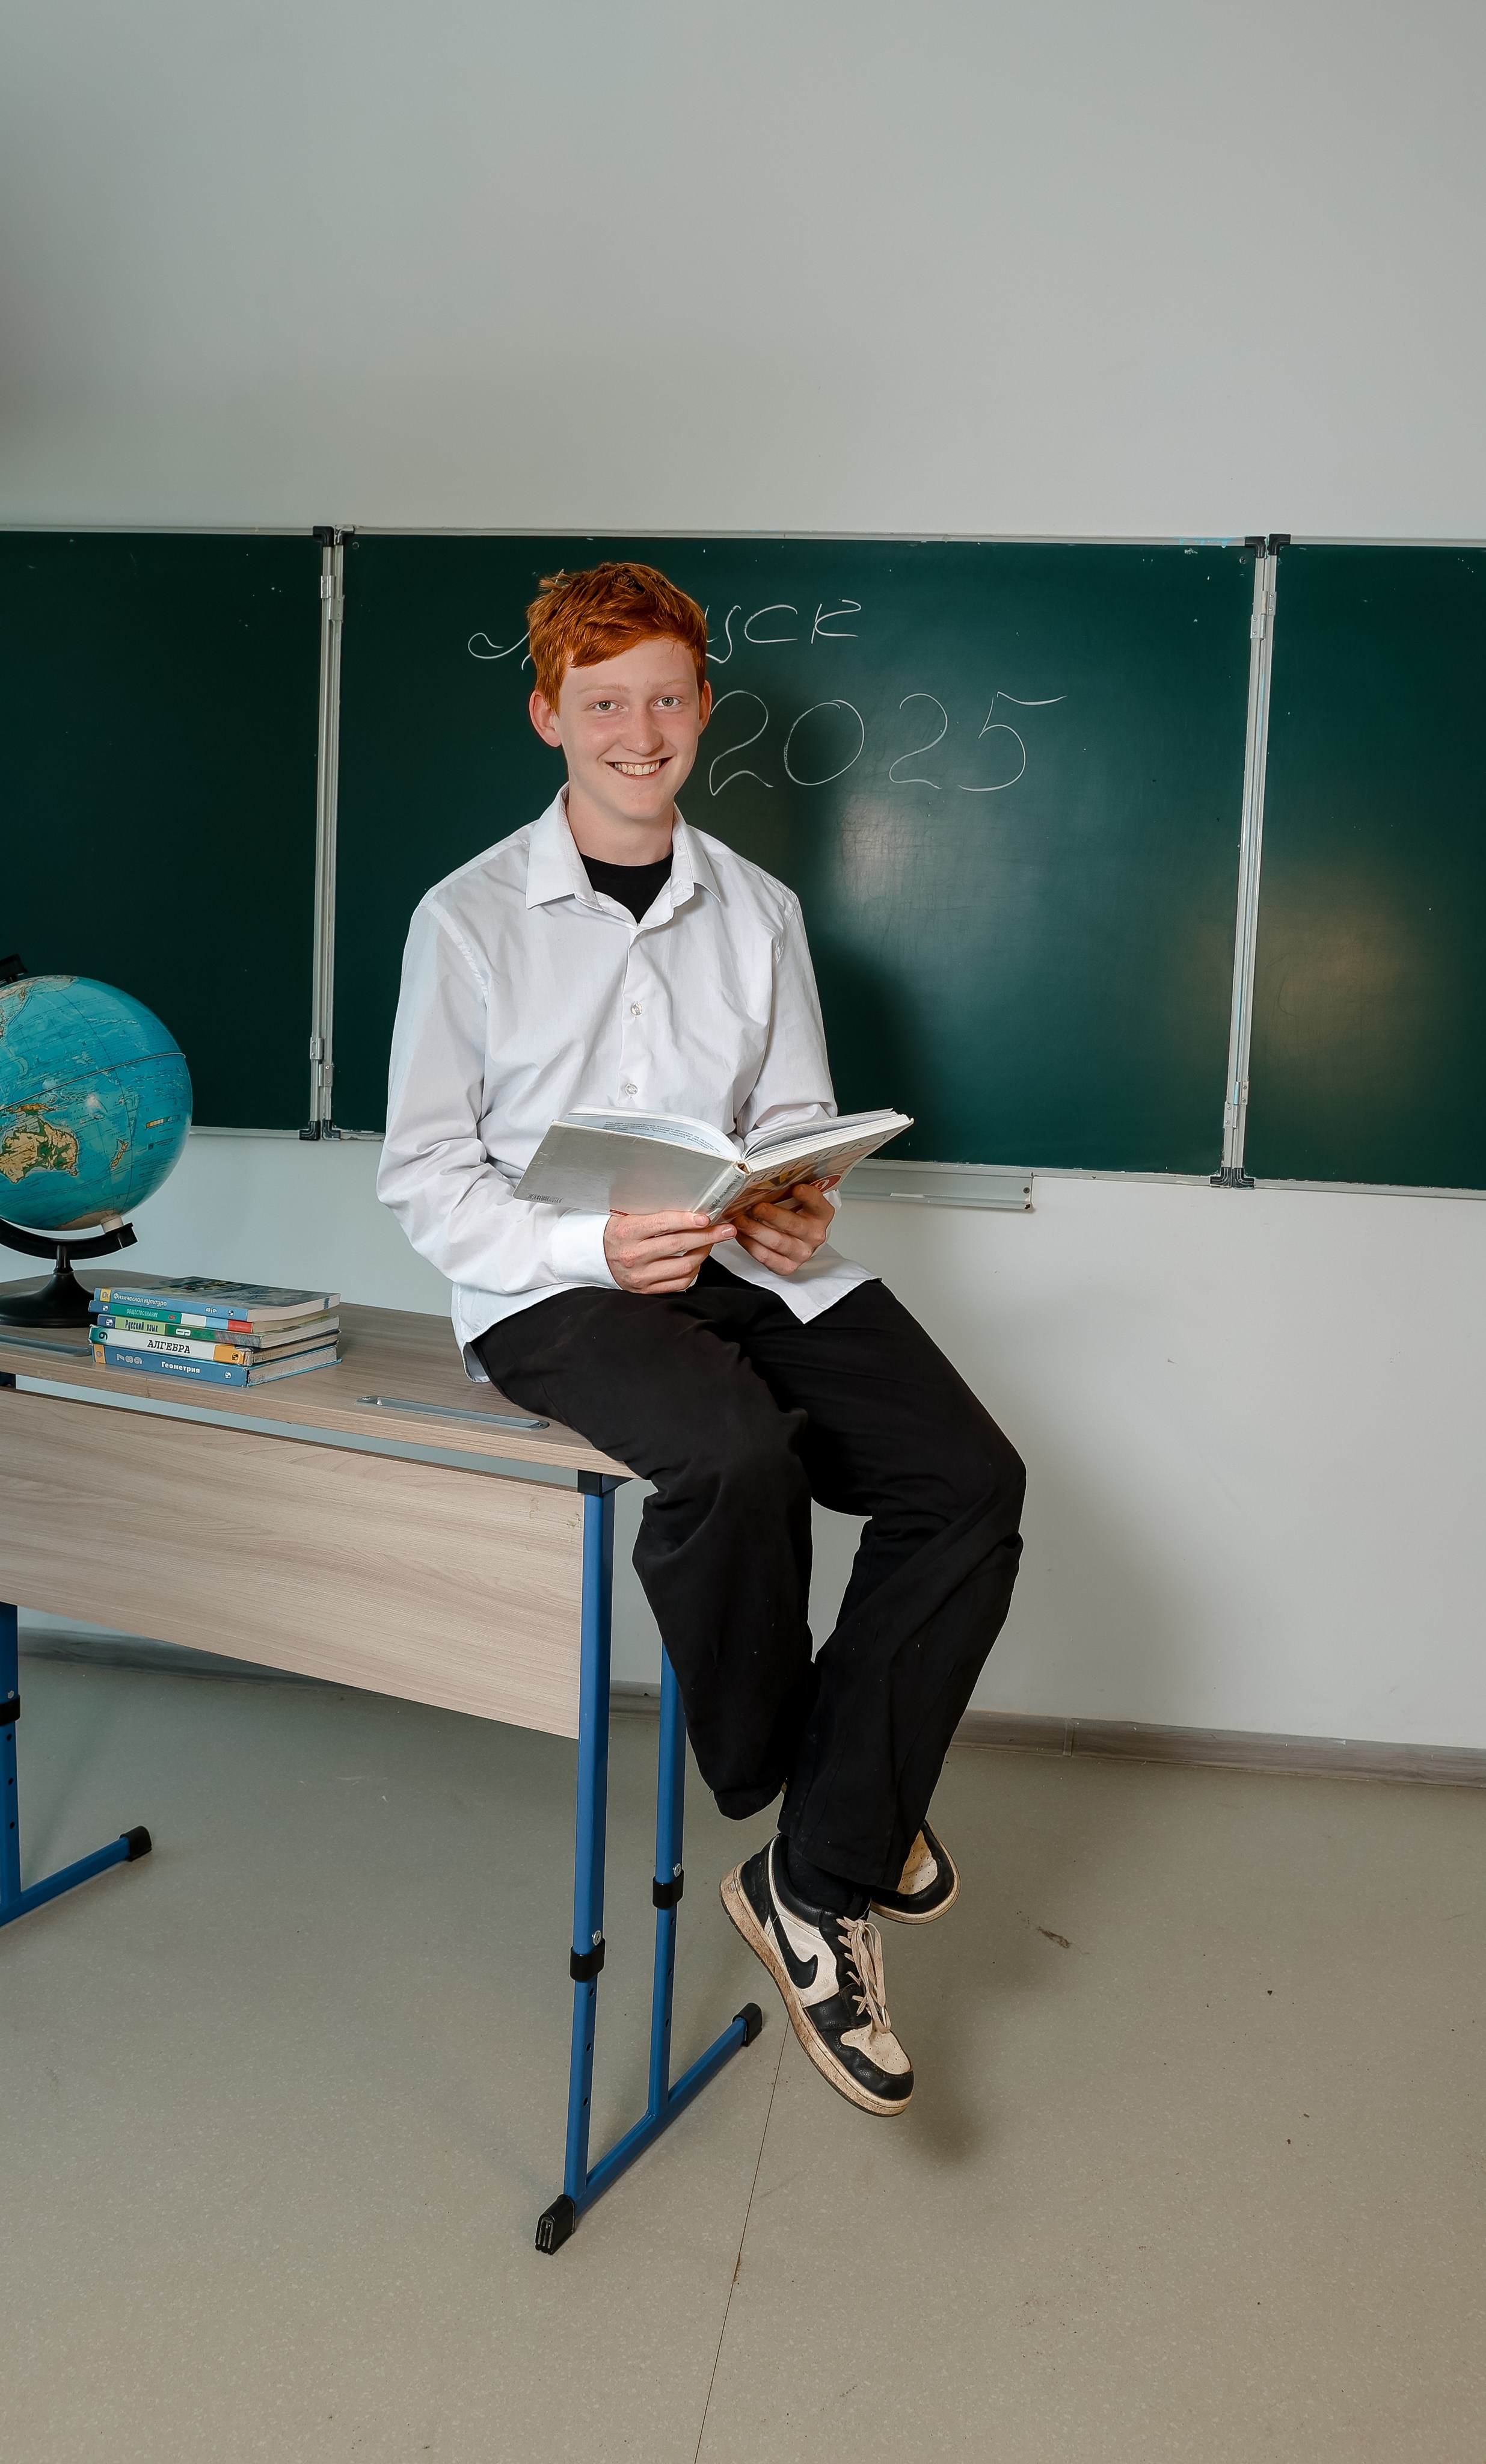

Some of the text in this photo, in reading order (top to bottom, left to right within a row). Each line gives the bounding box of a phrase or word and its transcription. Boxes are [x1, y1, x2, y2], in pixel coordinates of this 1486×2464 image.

[709, 690, 1066, 796] 2025
[113, 1293, 167, 1307] Физическая культура
[126, 1308, 158, 1318] ОБЩЕСТВОЗНАНИЕ
[124, 1319, 158, 1332] Русский язык
[147, 1339, 191, 1354] АЛГЕБРА
[161, 1361, 200, 1374] Геометрия
